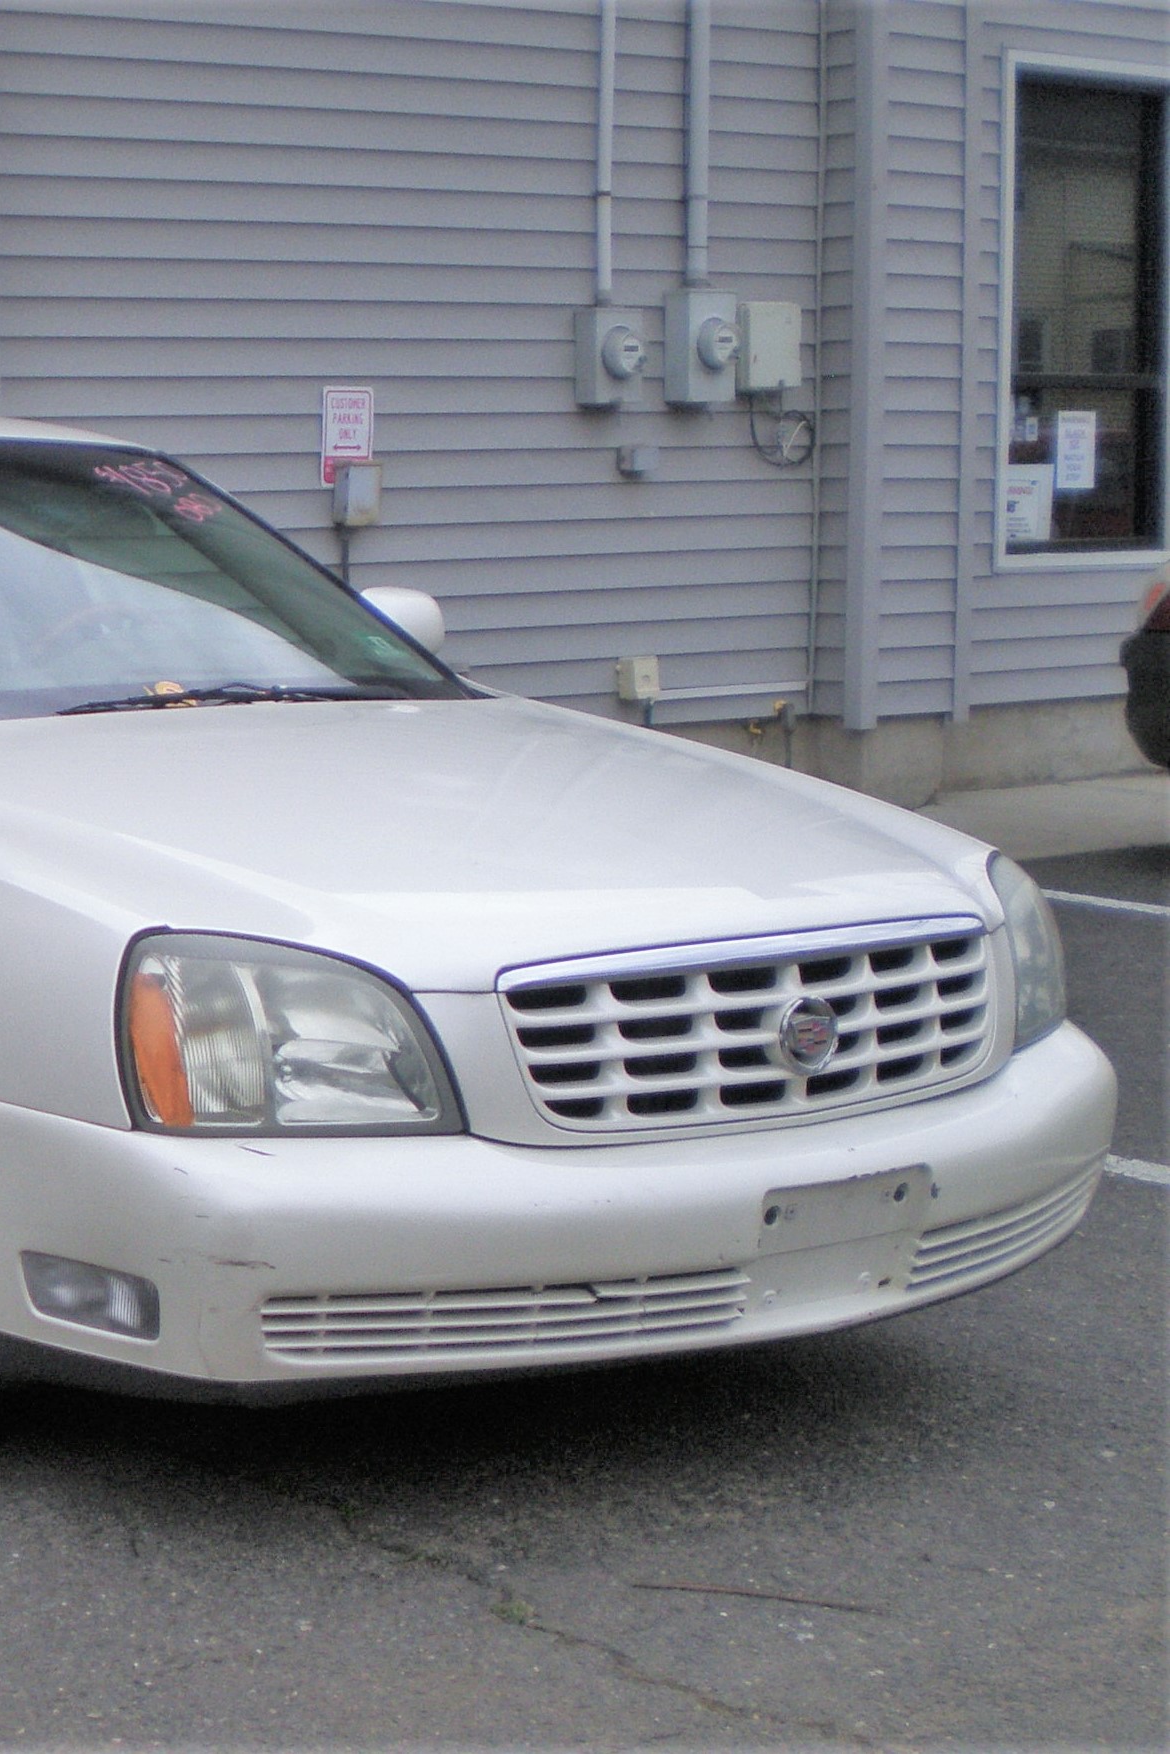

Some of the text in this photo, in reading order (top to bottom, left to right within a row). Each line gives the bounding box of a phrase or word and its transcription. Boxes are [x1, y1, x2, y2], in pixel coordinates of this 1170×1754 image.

[331, 397, 366, 409] CUSTOMER
[332, 413, 363, 425] PARKING
[338, 428, 357, 440] ONLY
